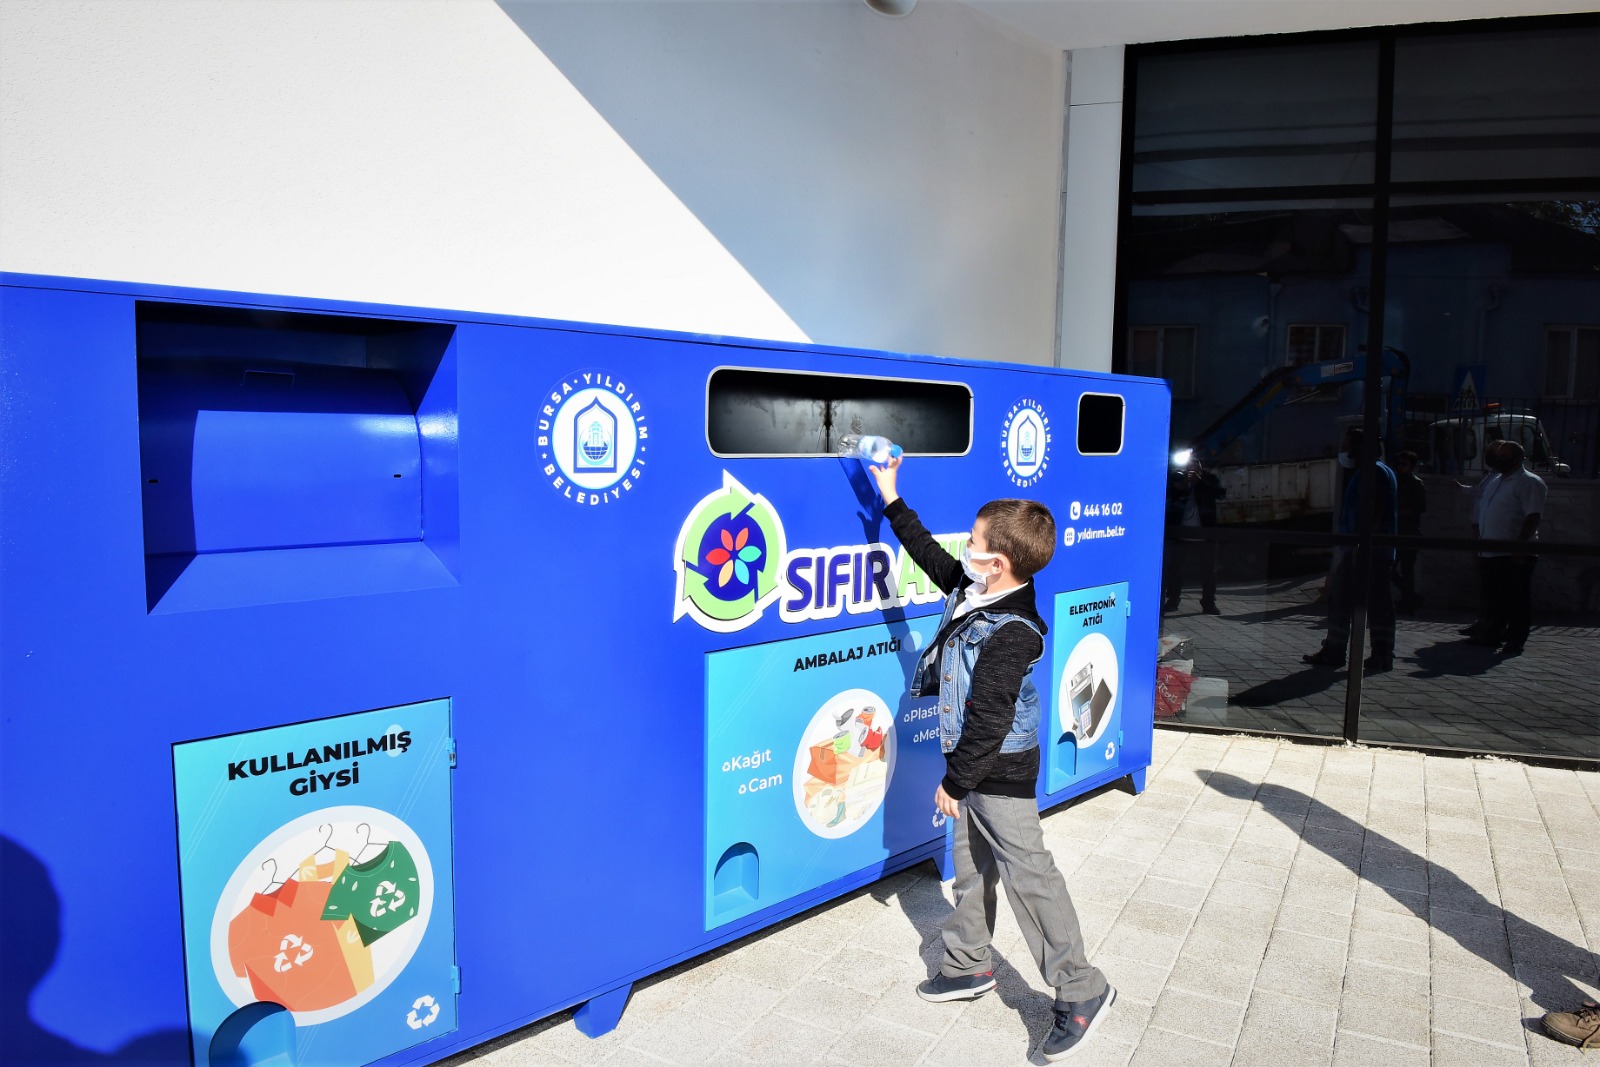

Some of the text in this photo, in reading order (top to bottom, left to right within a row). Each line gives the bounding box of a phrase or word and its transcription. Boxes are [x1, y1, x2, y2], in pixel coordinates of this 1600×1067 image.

[538, 373, 648, 446] BURSA YILDIRIM
[1001, 398, 1052, 448] BURSA YILDIRIM
[1083, 502, 1123, 517] 444 16 02
[786, 550, 891, 612] SIFIR
[1069, 595, 1116, 616] ELEKTRONİK
[1082, 612, 1103, 627] ATIĞI
[793, 636, 901, 672] AMBALAJ ATIĞI
[910, 701, 941, 722] Plasti
[919, 726, 941, 743] Met
[228, 731, 412, 781] KULLANILMIŞ
[731, 749, 772, 771] Kağıt
[289, 761, 359, 796] GİYSİ
[748, 773, 783, 792] Cam
